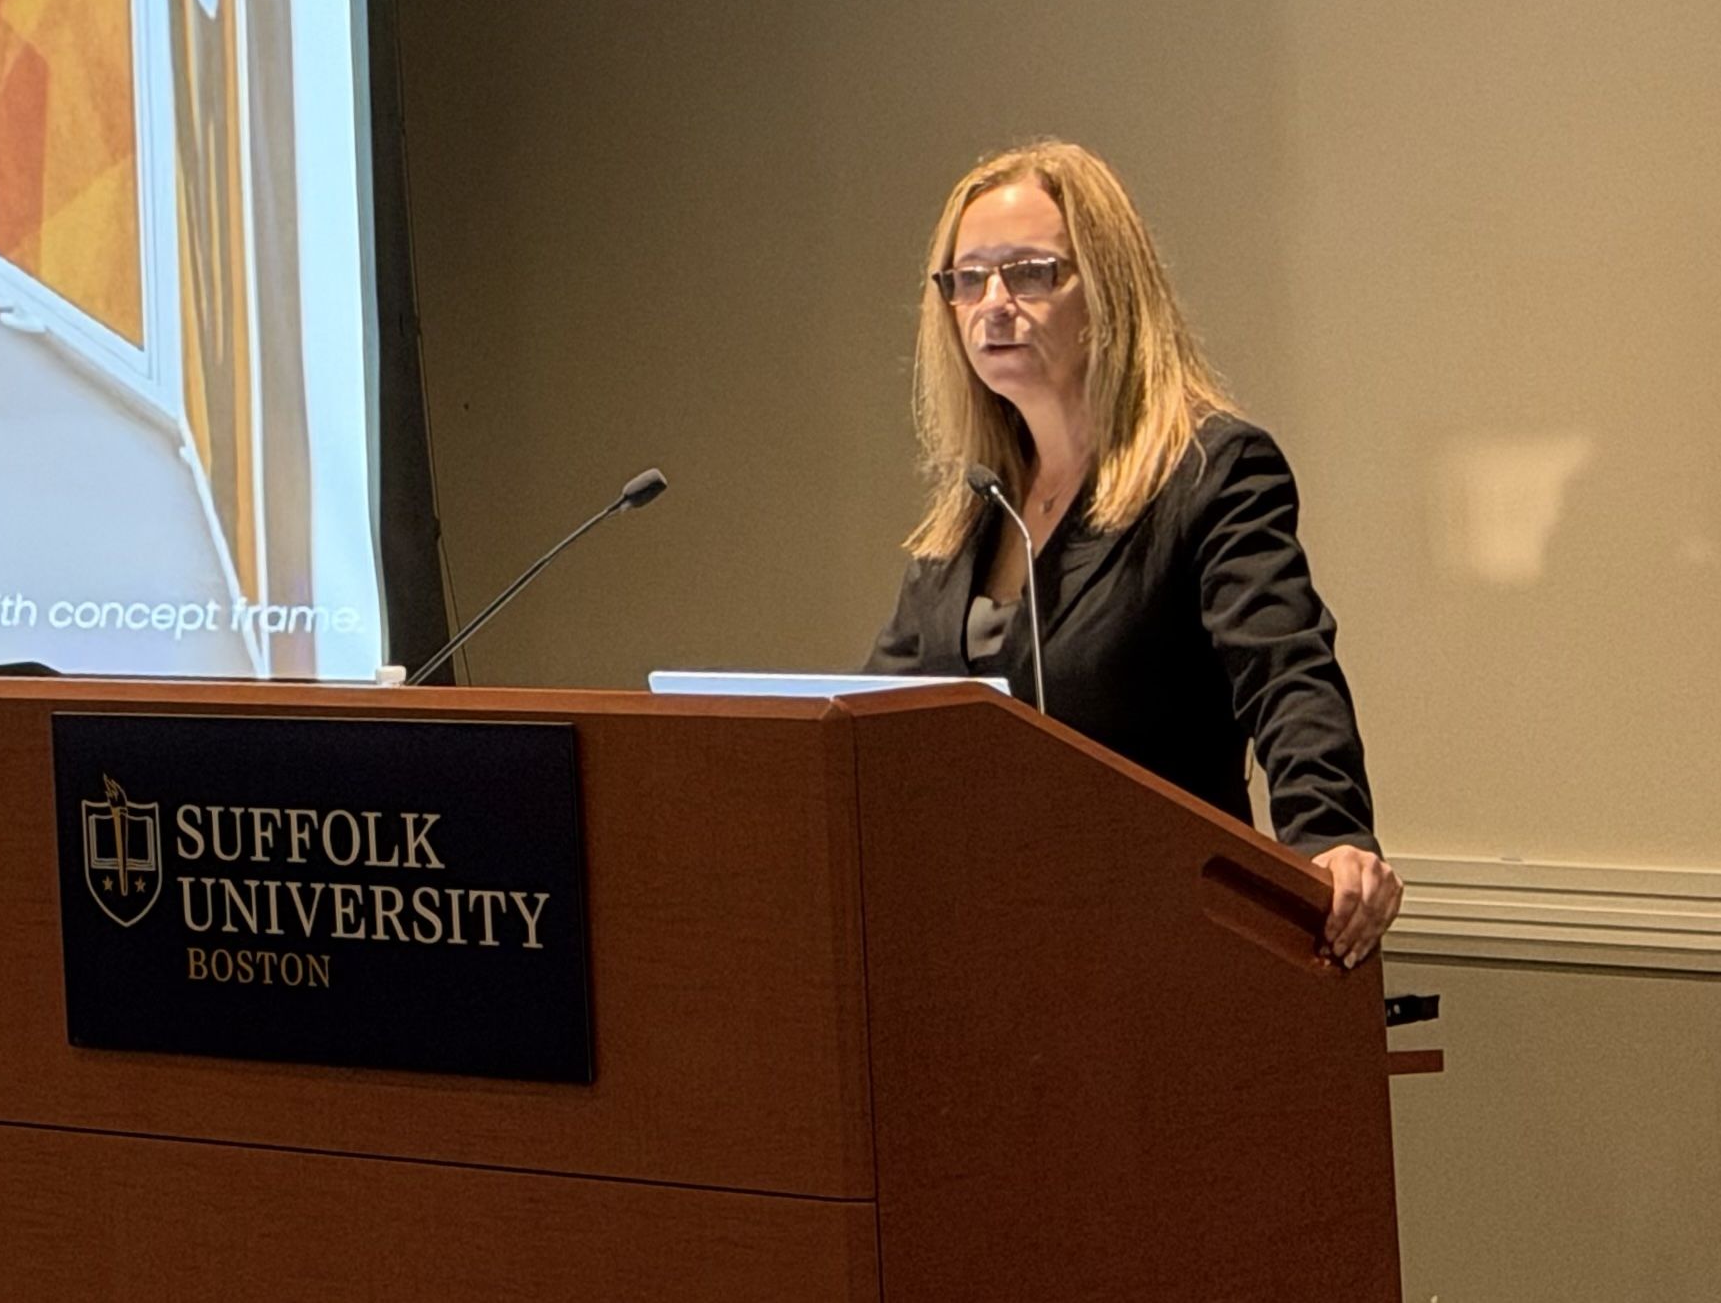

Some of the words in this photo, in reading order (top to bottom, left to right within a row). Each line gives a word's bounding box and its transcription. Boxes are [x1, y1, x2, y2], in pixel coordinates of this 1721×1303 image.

[48, 597, 221, 640] concept
[176, 803, 446, 869] SUFFOLK
[177, 876, 550, 949] UNIVERSITY
[187, 947, 331, 988] BOSTON
